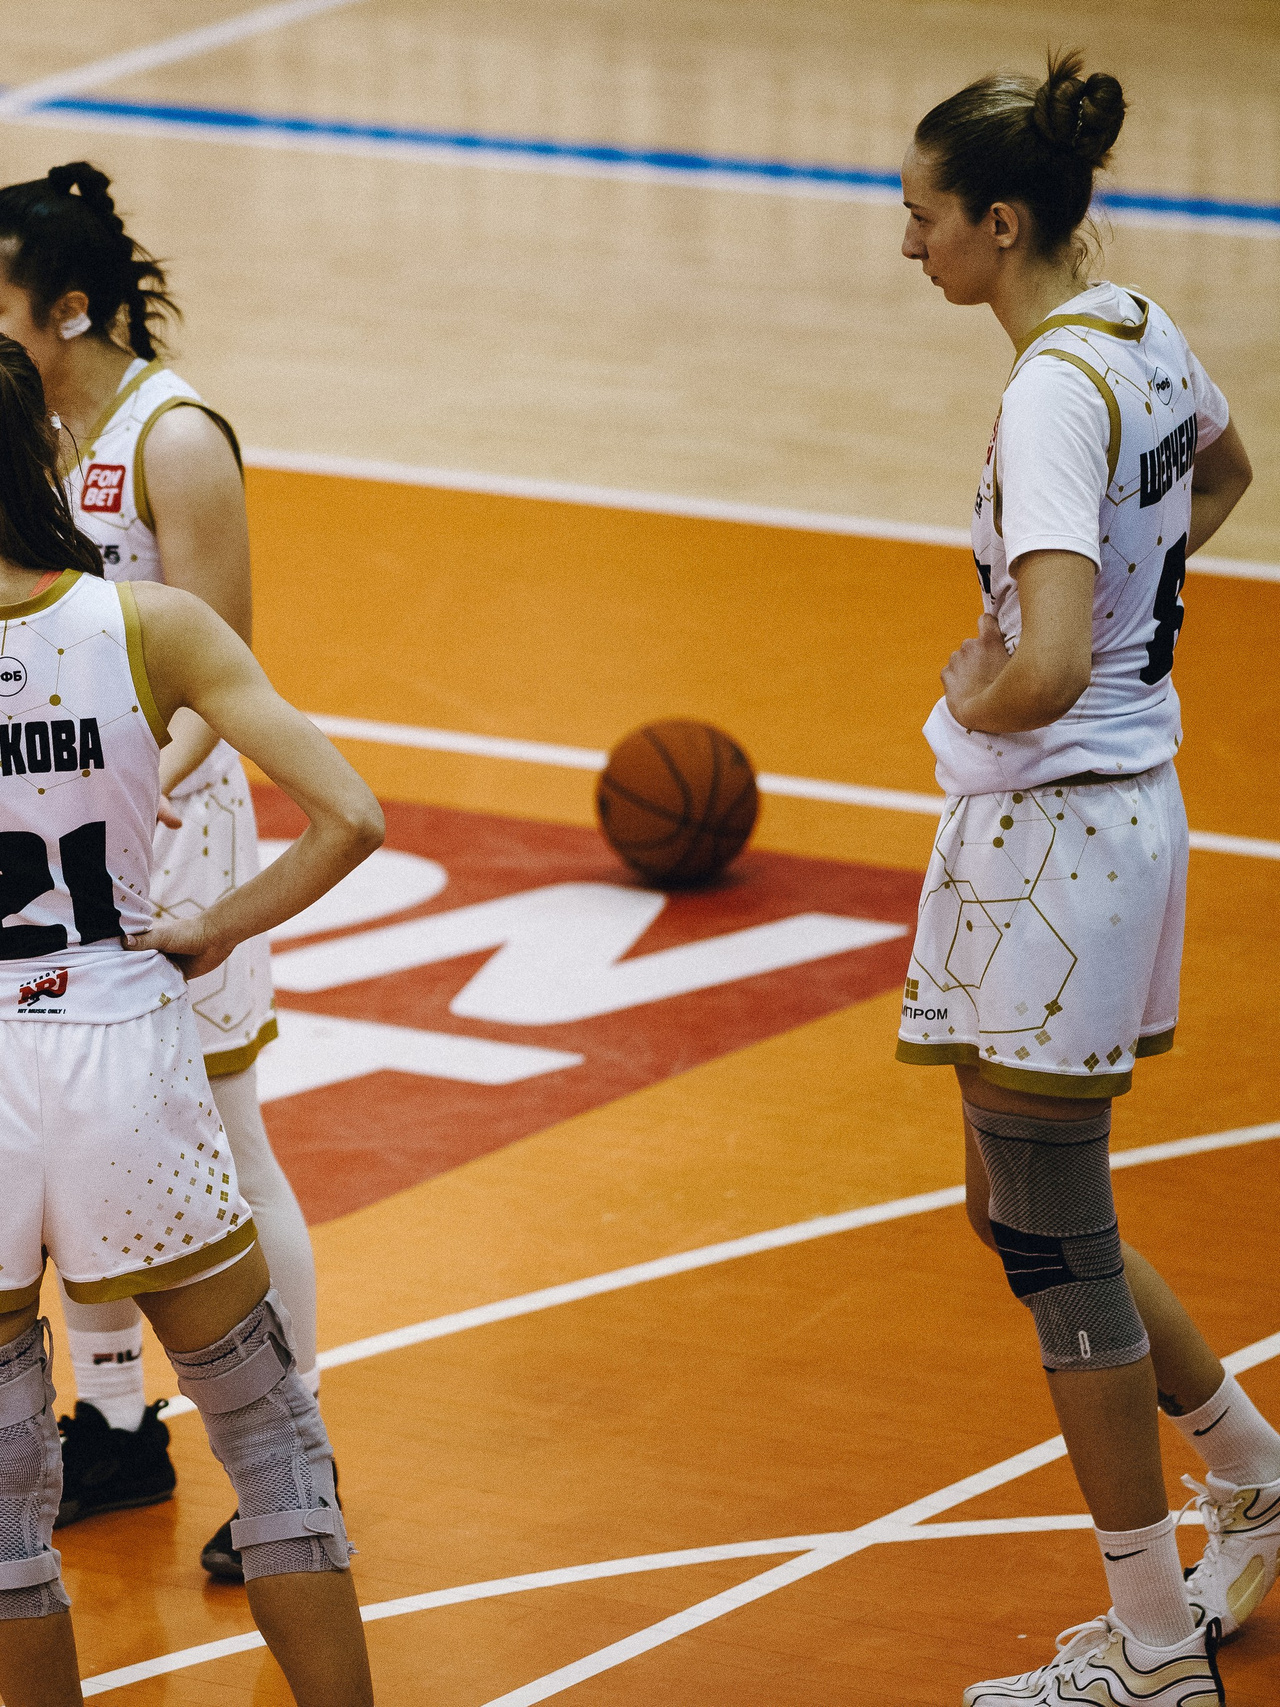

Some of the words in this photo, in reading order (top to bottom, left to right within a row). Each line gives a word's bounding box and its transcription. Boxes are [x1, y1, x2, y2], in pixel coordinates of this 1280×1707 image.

[1155, 378, 1171, 394] РФБ
[86, 468, 123, 487] FON
[83, 486, 120, 507] BET
[902, 1005, 948, 1021] ПРОМ
